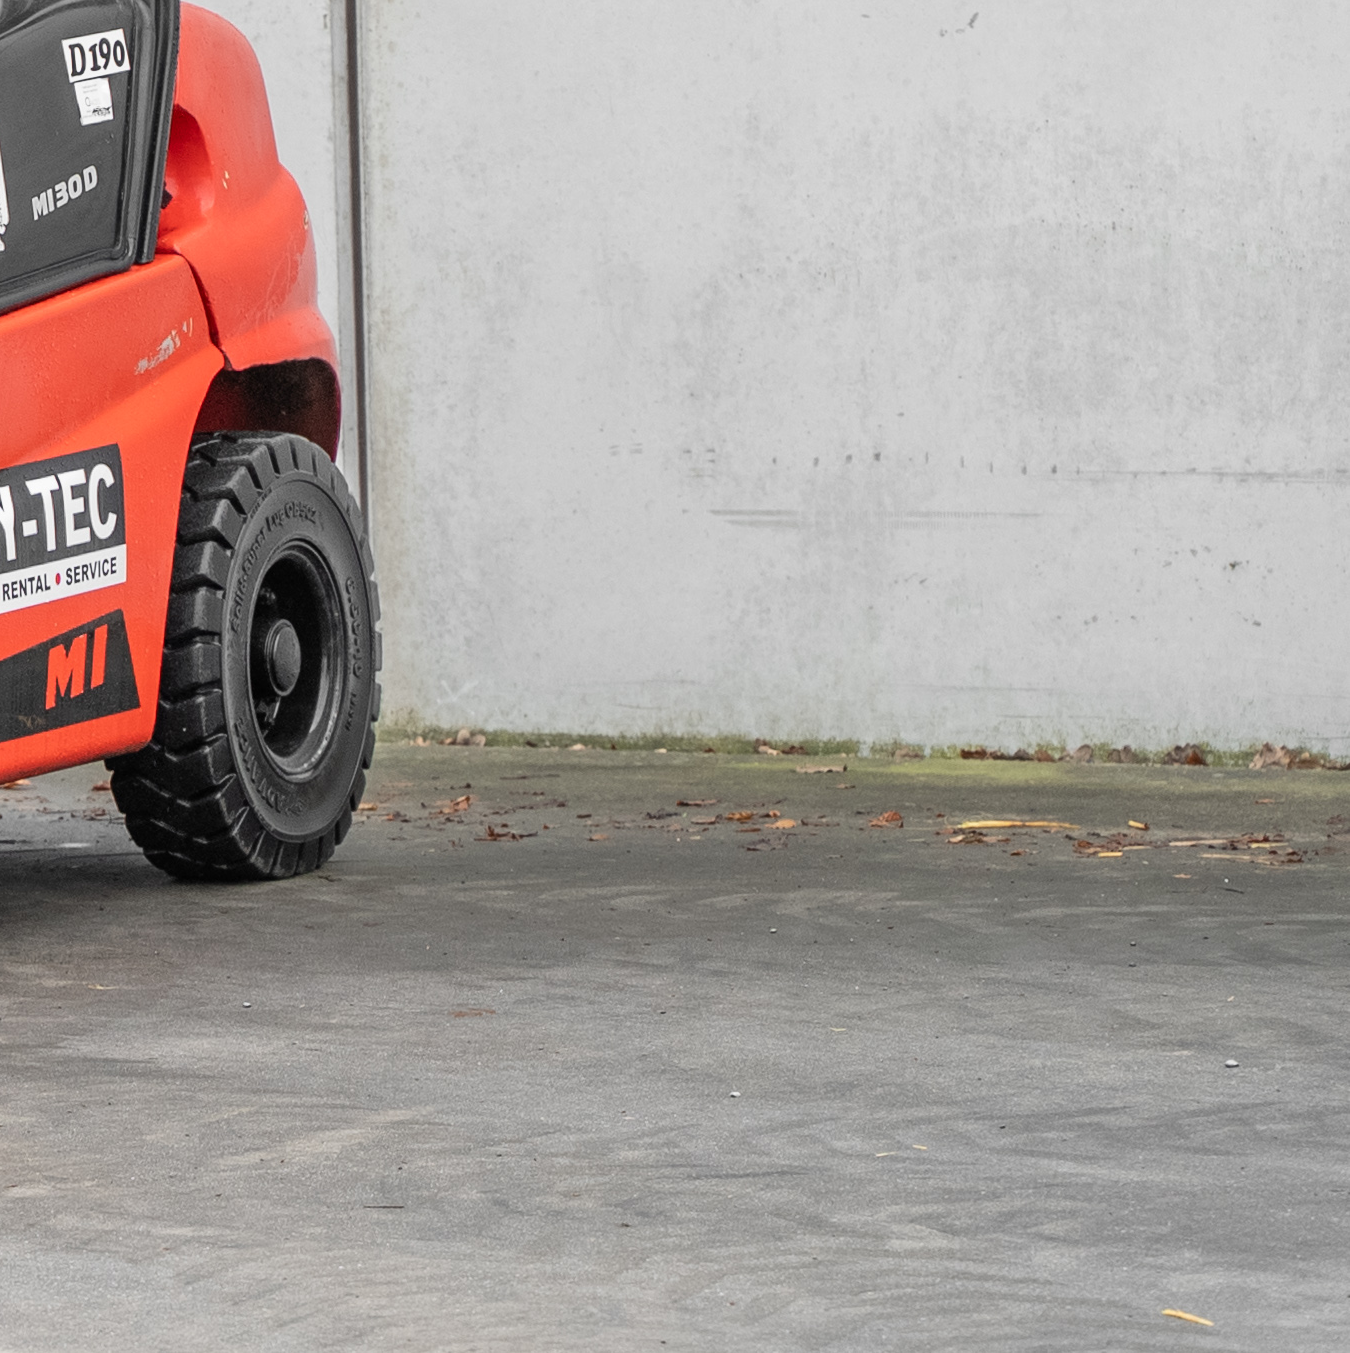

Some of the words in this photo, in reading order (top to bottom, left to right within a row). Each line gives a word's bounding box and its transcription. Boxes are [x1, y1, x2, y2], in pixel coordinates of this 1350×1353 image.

[68, 37, 125, 77] D190
[2, 573, 51, 602] RENTAL
[65, 556, 117, 586] SERVICE
[45, 624, 108, 710] MI
